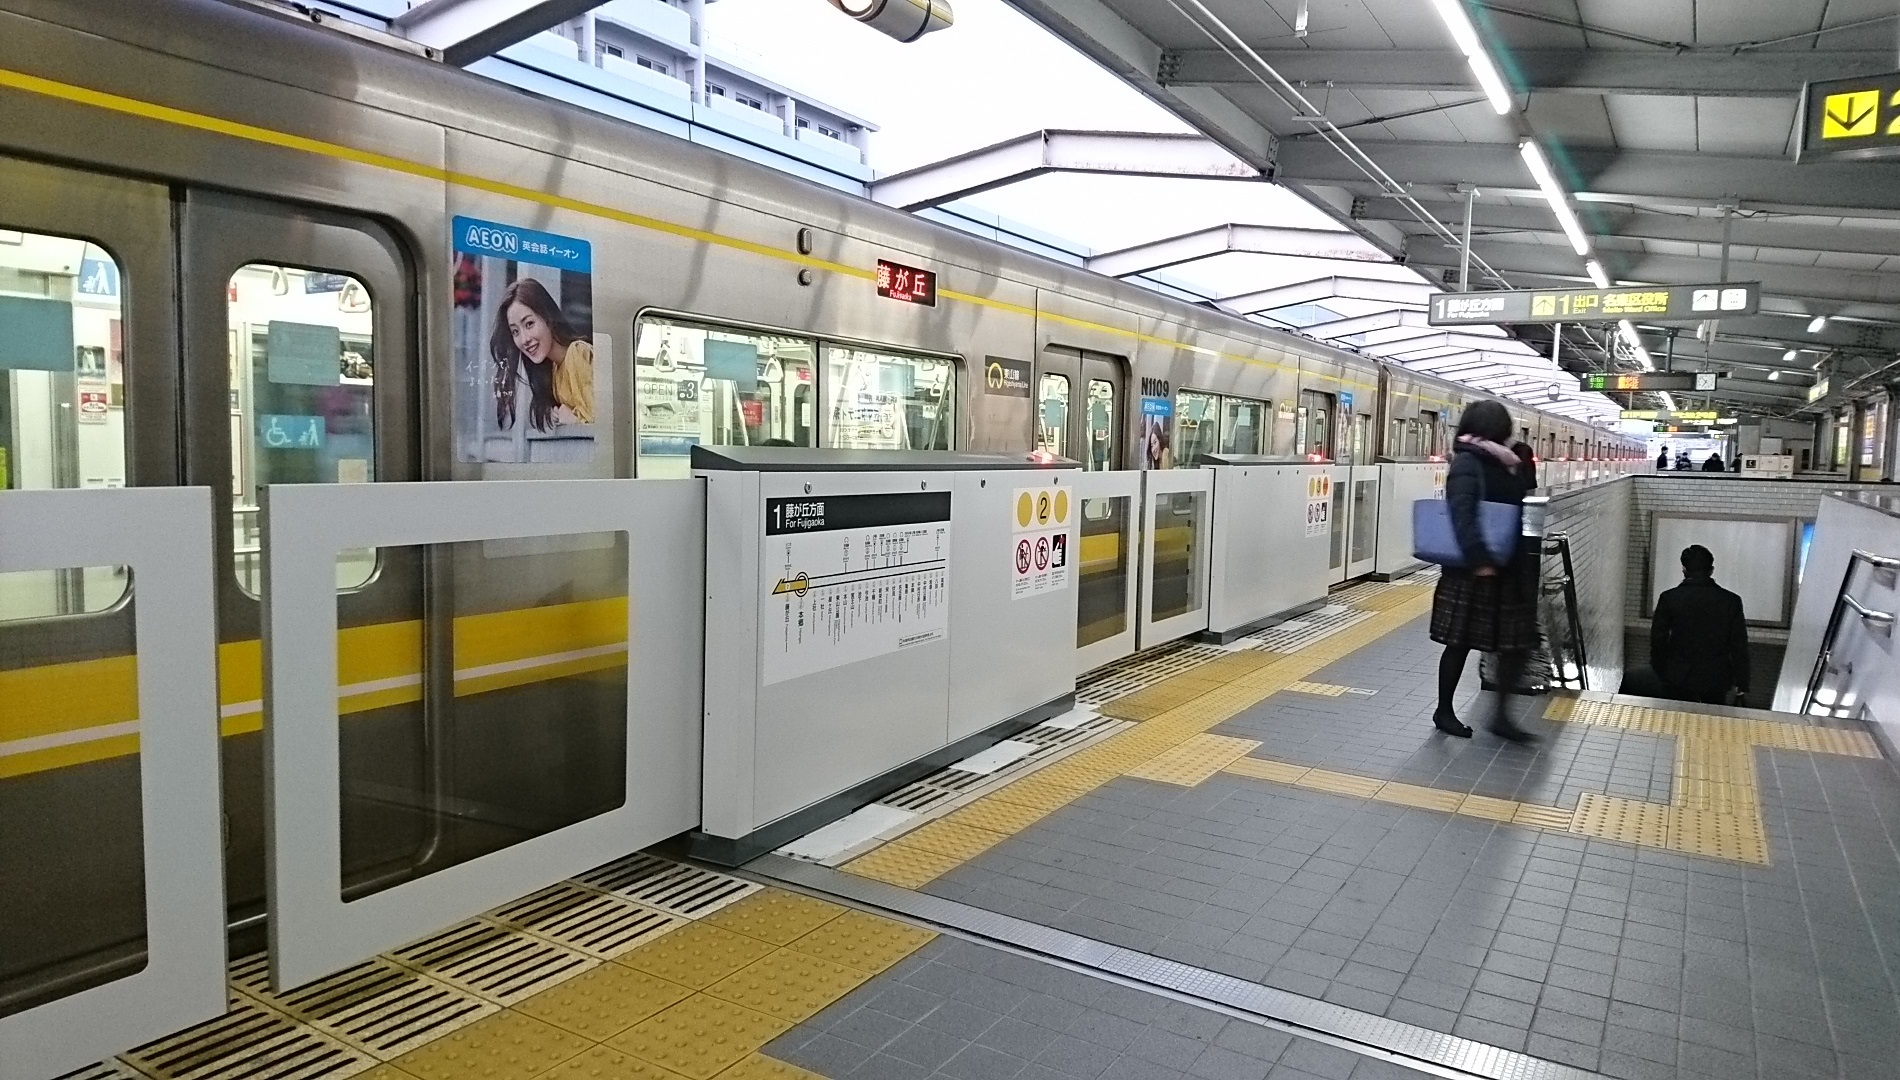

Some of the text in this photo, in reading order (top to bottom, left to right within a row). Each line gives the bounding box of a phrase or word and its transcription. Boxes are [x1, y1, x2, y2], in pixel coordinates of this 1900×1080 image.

[467, 226, 517, 253] AEON
[522, 241, 579, 259] 英会話イーオン
[877, 264, 926, 296] 藤が丘
[1435, 299, 1445, 319] 1
[1559, 294, 1570, 315] 1
[1573, 294, 1599, 308] 出口
[643, 382, 673, 396] OPEN
[686, 382, 695, 399] 3
[1141, 376, 1170, 398] N1109
[773, 502, 825, 529] 1 藤が丘方面
[1040, 496, 1048, 520] 2
[785, 517, 825, 529] For Fujigaoka
